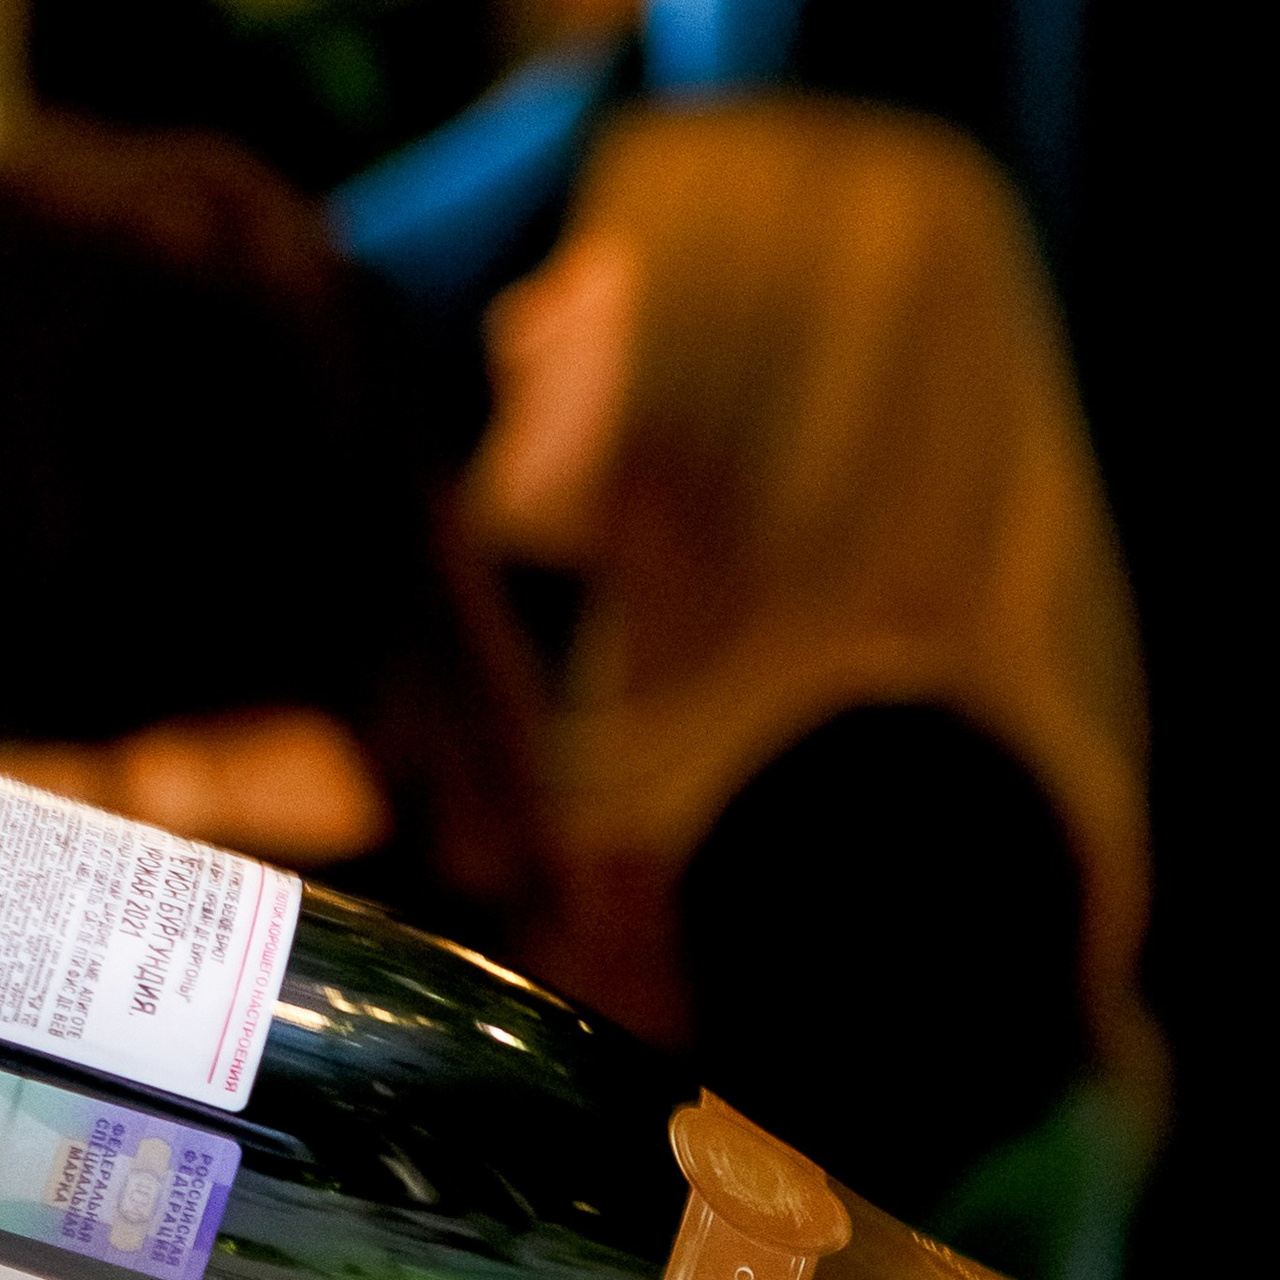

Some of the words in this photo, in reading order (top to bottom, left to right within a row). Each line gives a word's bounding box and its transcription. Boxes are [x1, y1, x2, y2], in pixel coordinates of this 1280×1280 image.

[130, 843, 165, 899] УРОЖАЯ
[160, 851, 197, 902] РЕГИОН
[118, 899, 151, 939] 2021
[191, 925, 210, 942] ДЕ
[208, 932, 231, 963] БРЮТ
[252, 920, 285, 987] ХОРОШЕГО
[54, 994, 74, 1011] ДЕ
[65, 985, 95, 1040] АЛИГОТЕ
[223, 988, 265, 1093] НАСТРОЕНИЯ
[53, 1145, 83, 1204] МАРКА
[60, 1116, 110, 1238] СПЕЦИАЛЬНАЯ
[76, 1121, 126, 1243] ФЕДЕРАЛЬНАЯ
[149, 1147, 197, 1263] ФЕДЕРАЦИЯ
[165, 1152, 213, 1267] РОССИЙСКАЯ
